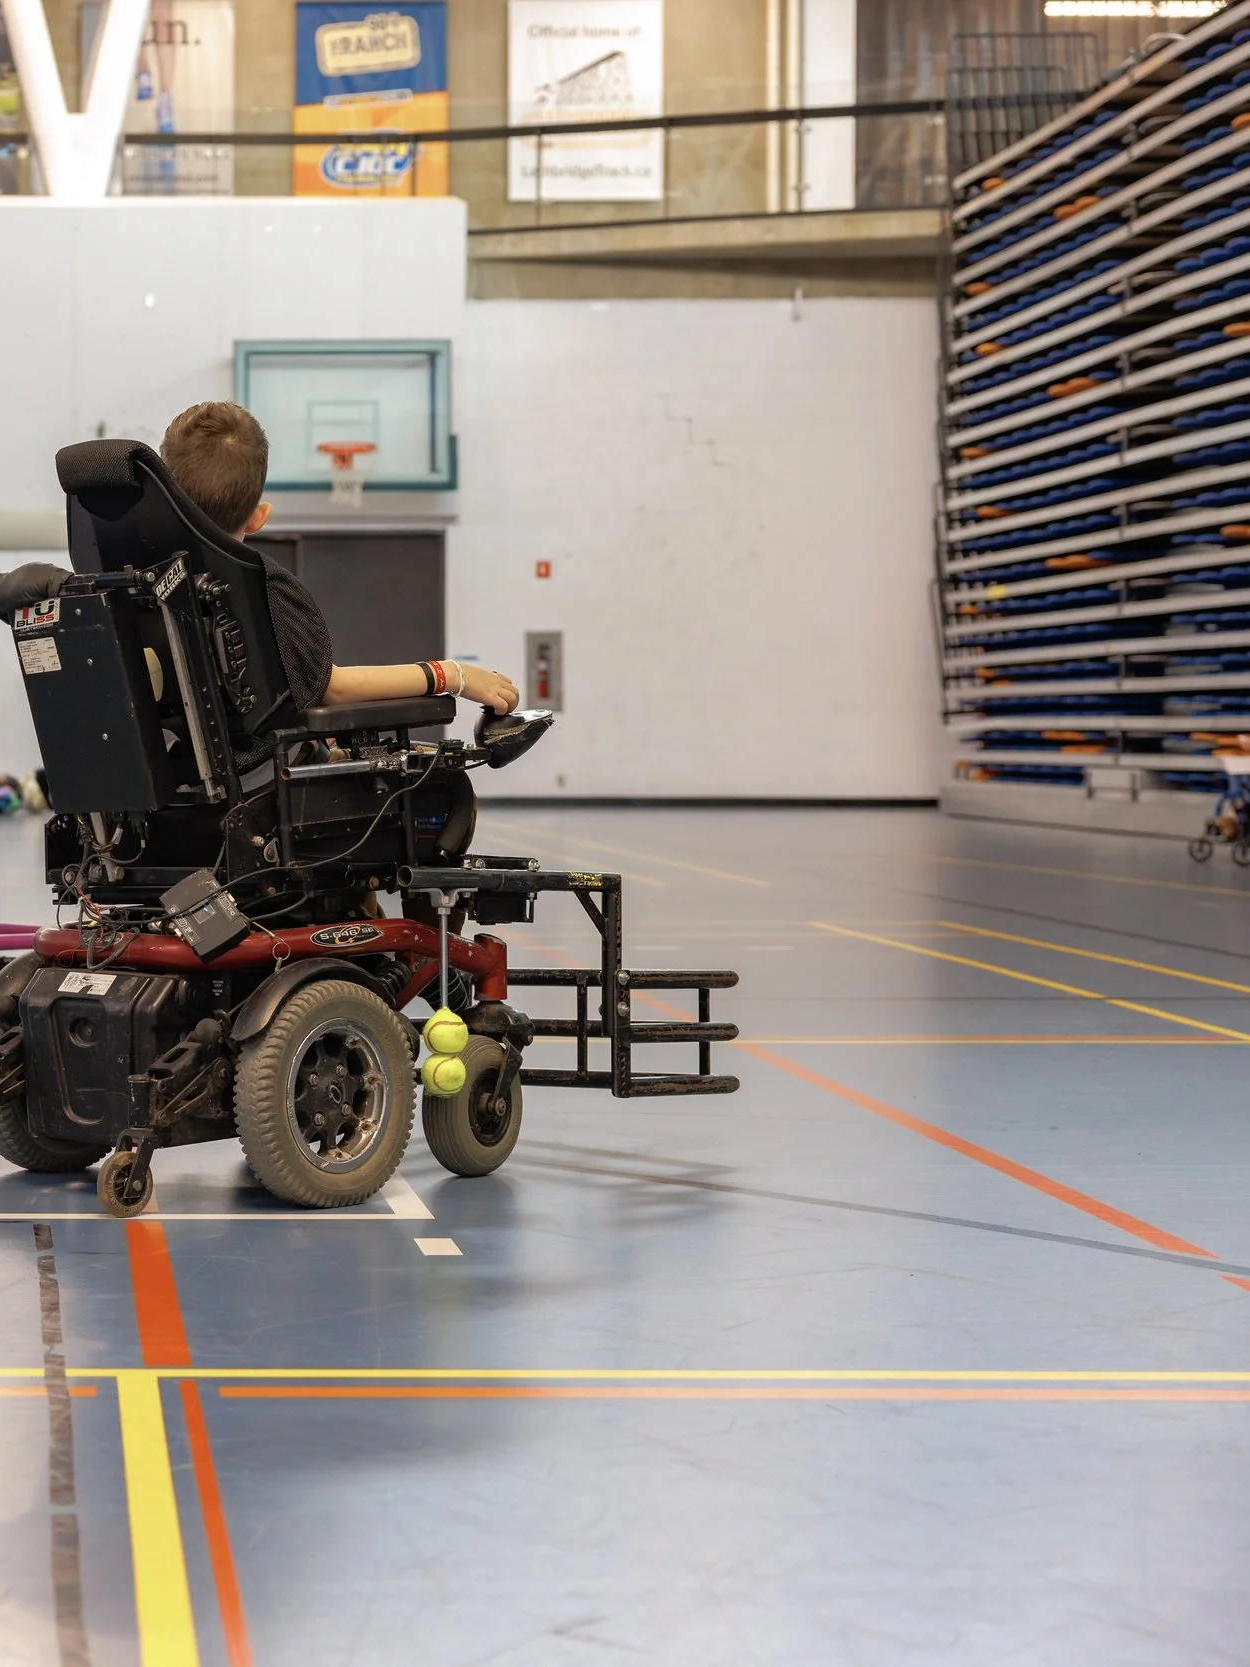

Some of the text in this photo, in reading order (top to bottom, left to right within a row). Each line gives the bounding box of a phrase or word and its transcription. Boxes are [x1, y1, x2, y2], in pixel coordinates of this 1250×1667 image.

[526, 24, 577, 38] Official
[155, 559, 183, 597] DECAL
[16, 614, 55, 628] BLISS
[319, 929, 358, 941] S-646
